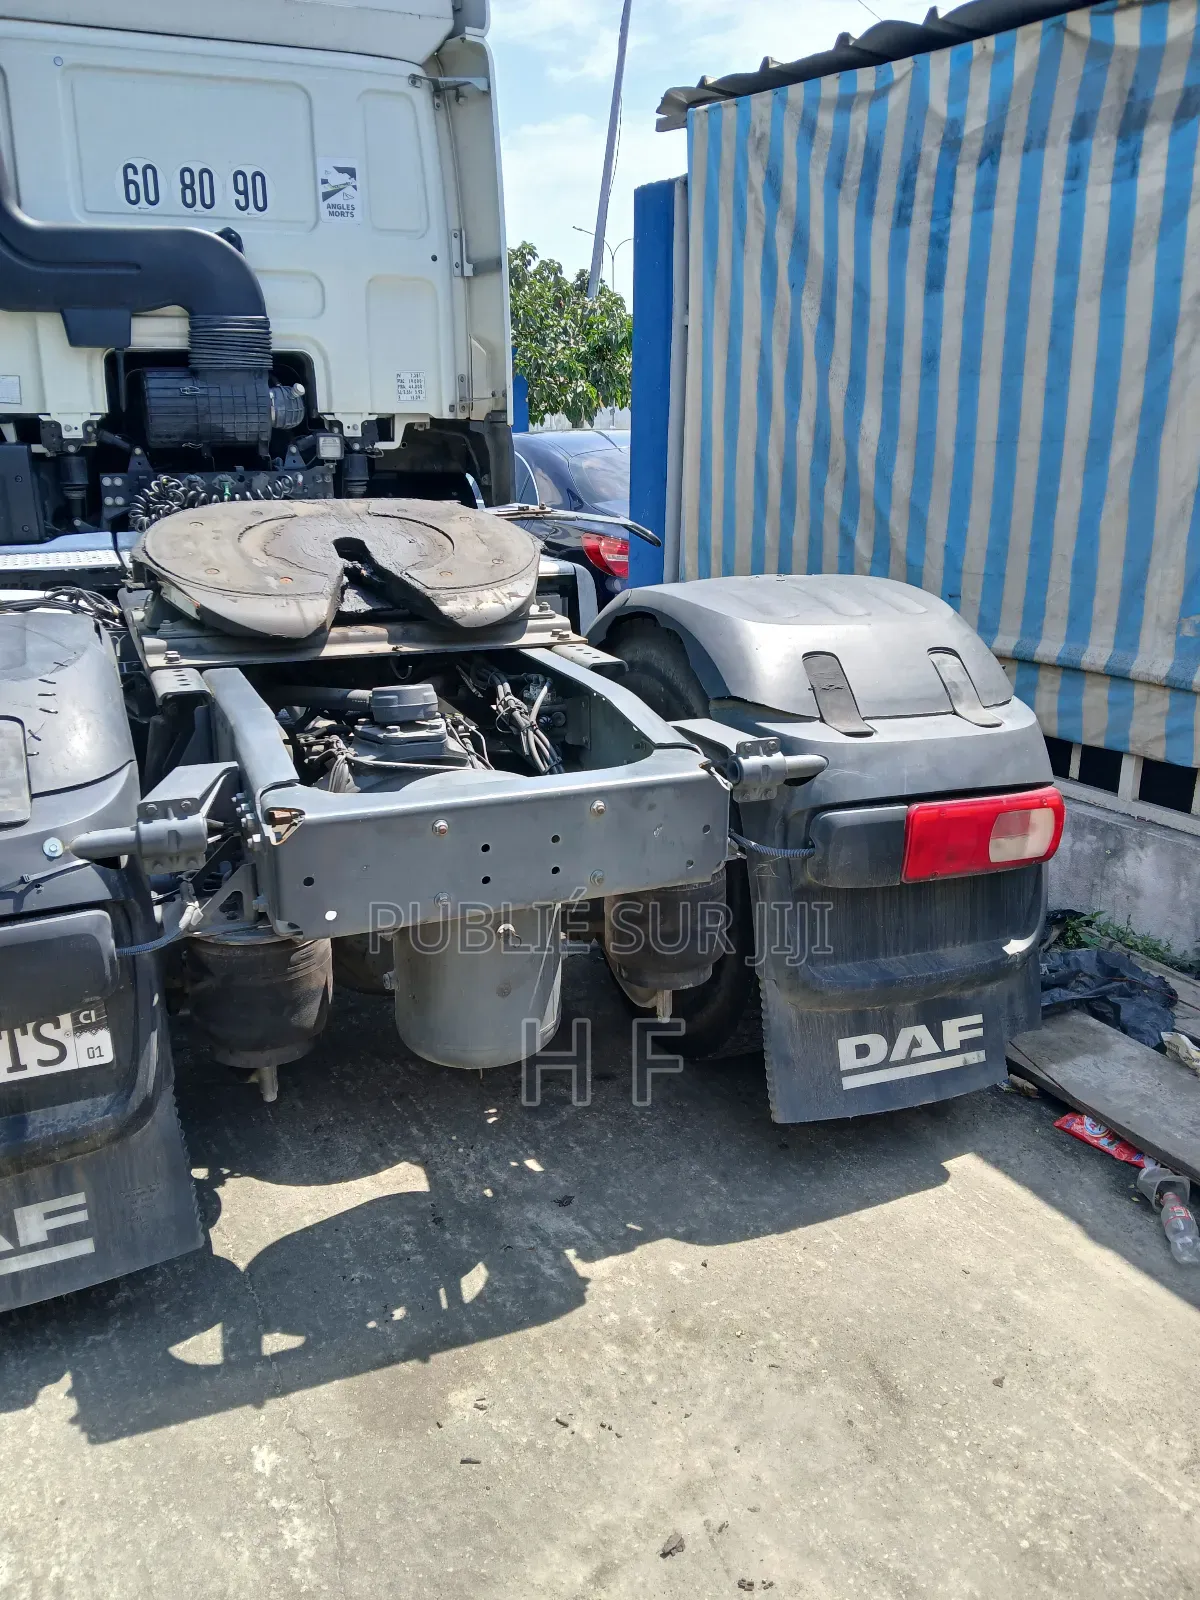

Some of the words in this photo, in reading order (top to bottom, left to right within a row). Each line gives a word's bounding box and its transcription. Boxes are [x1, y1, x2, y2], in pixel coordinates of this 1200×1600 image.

[122, 162, 160, 206] 60
[179, 166, 216, 210] 80
[232, 169, 268, 213] 90
[326, 203, 356, 211] ANGLES
[328, 210, 355, 218] MORTS
[79, 1009, 97, 1024] CI
[837, 1013, 984, 1071] DAF
[86, 1045, 105, 1060] 01
[0, 1191, 90, 1252] F
